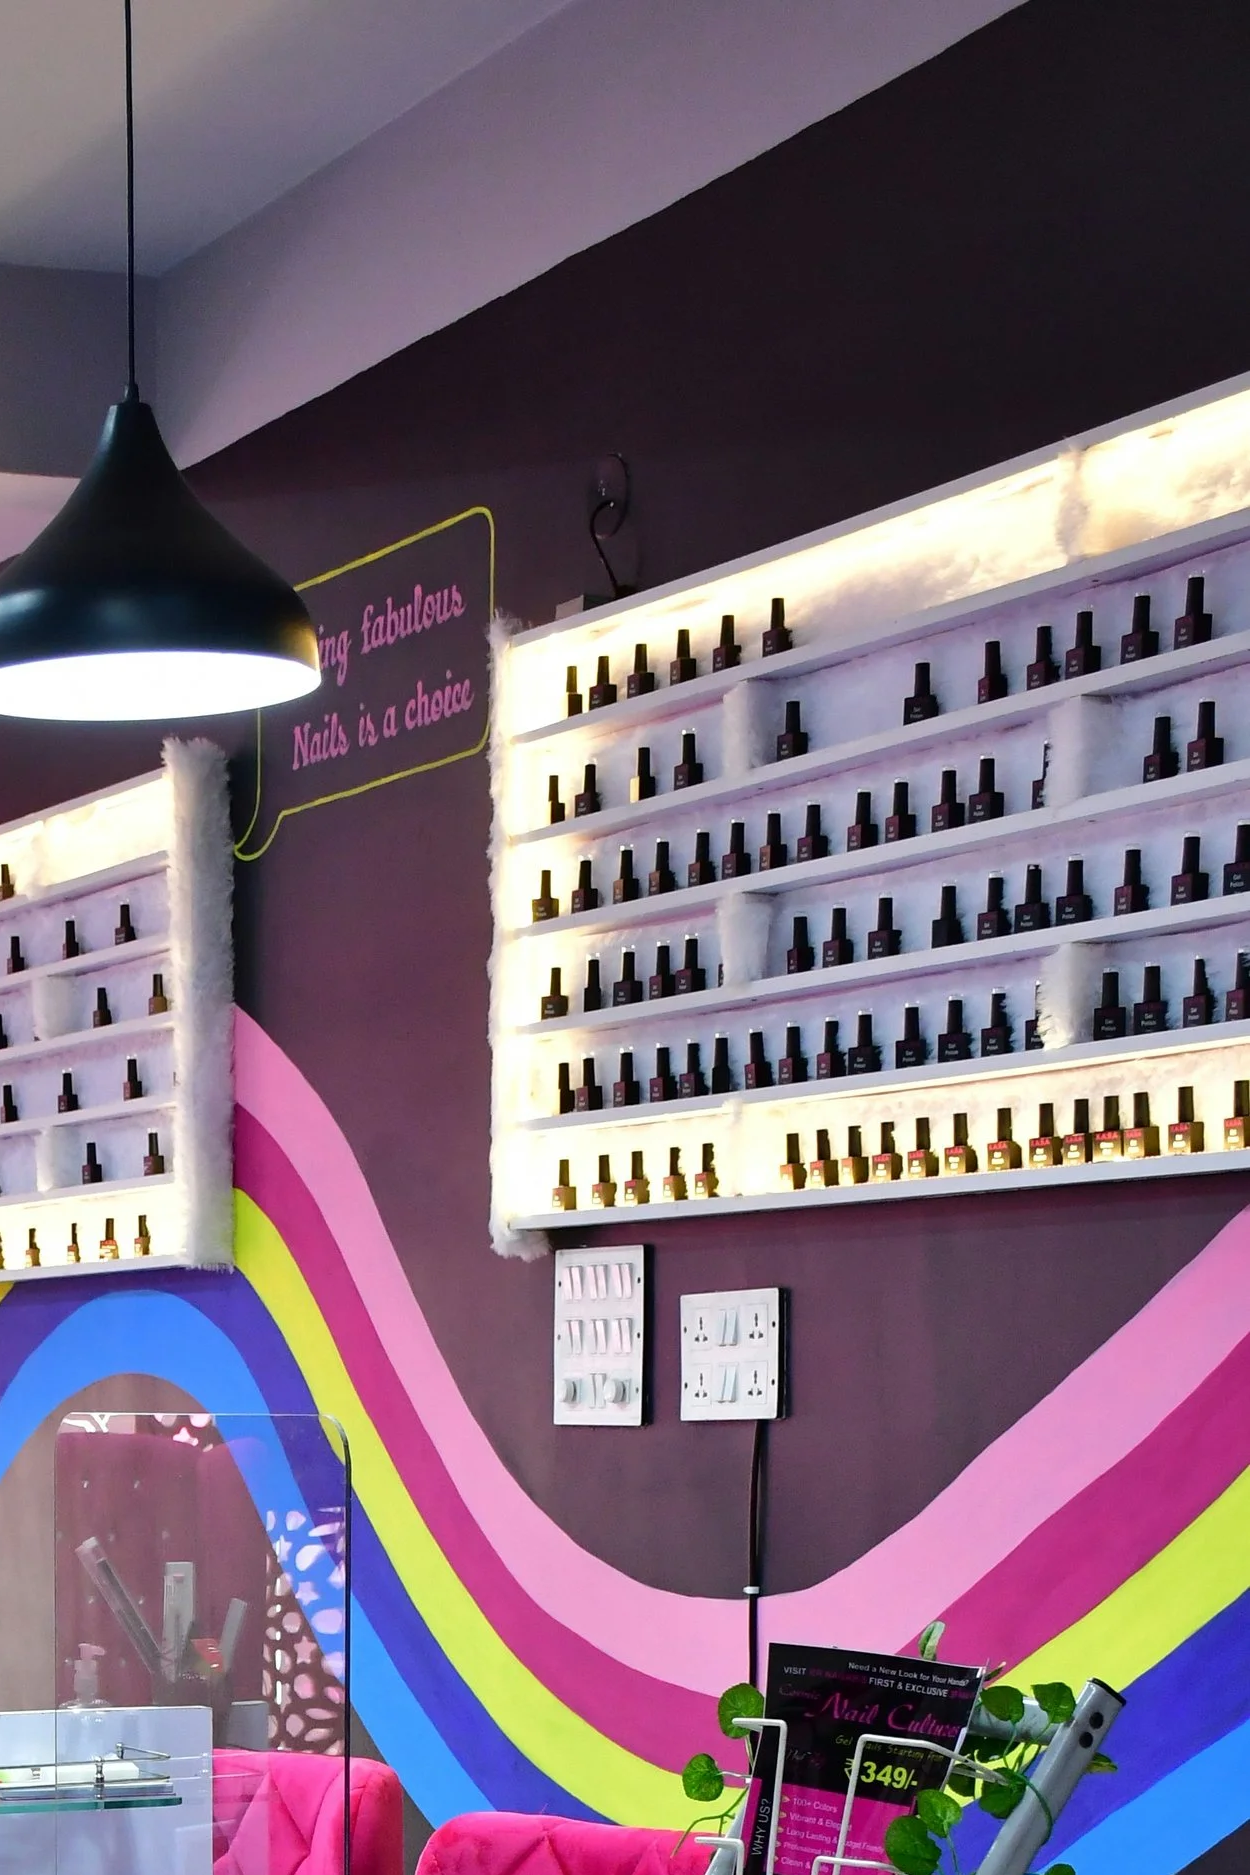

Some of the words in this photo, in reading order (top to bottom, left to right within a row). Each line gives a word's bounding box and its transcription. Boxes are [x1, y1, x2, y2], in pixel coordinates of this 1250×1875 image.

[361, 584, 468, 654] fabulous
[292, 712, 350, 770] Nails
[358, 702, 380, 748] is
[383, 704, 398, 738] a
[405, 669, 474, 730] choice
[783, 1666, 807, 1676] VISIT
[869, 1677, 894, 1689] FIRST
[896, 1681, 903, 1690] &
[905, 1682, 949, 1698] EXCLUSIVE
[804, 1692, 880, 1726] Nail
[751, 1826, 765, 1856] WHY
[759, 1798, 772, 1824] US?
